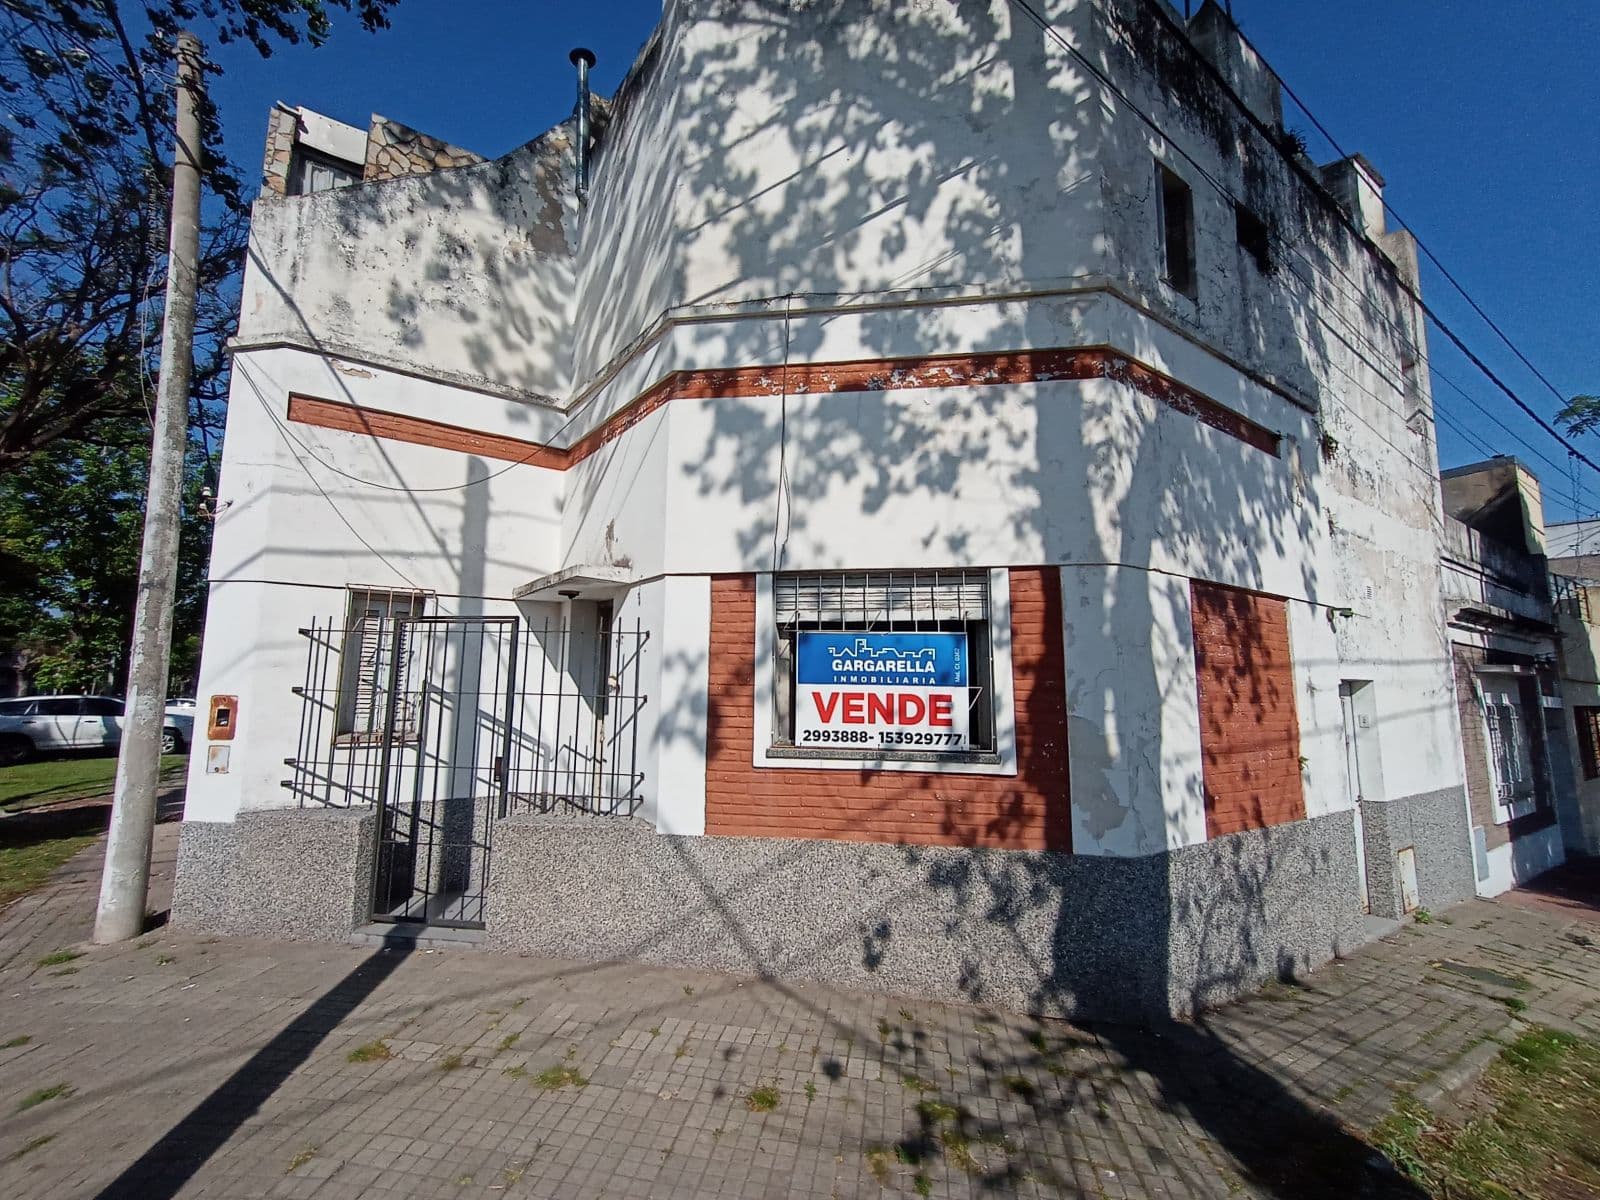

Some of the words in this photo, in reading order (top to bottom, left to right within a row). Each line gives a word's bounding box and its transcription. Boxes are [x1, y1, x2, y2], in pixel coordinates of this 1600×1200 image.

[832, 659, 936, 673] GARGARELLA
[834, 675, 936, 684] INMOBILIARIA
[812, 691, 953, 726] VENDE
[878, 732, 962, 746] 153929777
